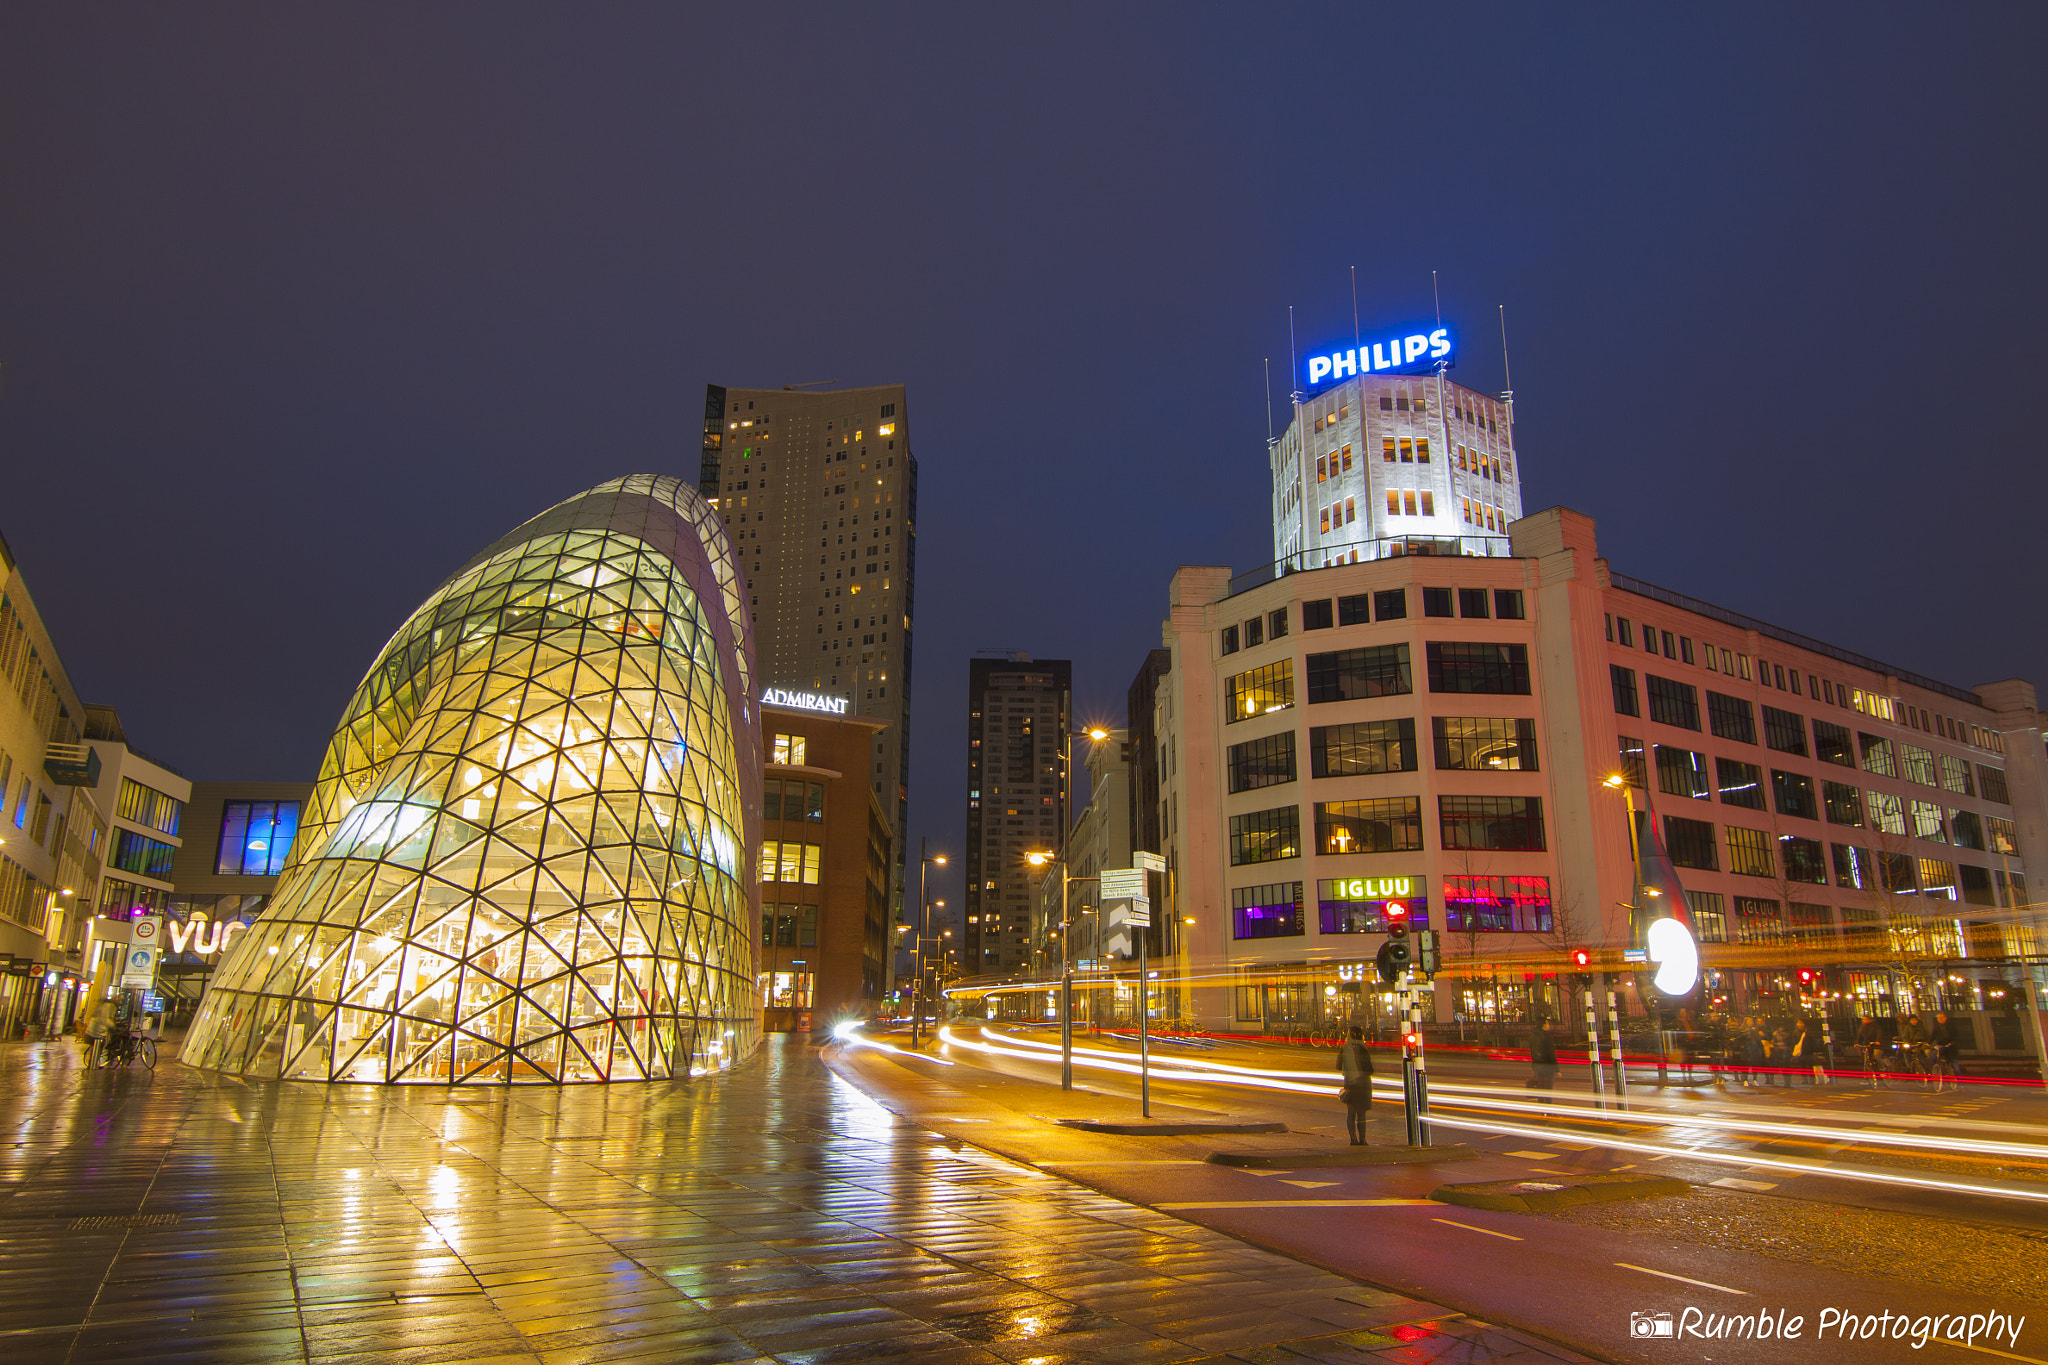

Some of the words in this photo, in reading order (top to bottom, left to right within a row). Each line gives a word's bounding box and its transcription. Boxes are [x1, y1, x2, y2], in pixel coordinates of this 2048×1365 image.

[1309, 328, 1451, 384] PHILIPS
[762, 687, 848, 713] ADMIRANT
[1340, 878, 1409, 897] IGLUU
[1294, 885, 1304, 930] MEETINGS
[1742, 899, 1774, 915] IGLUU
